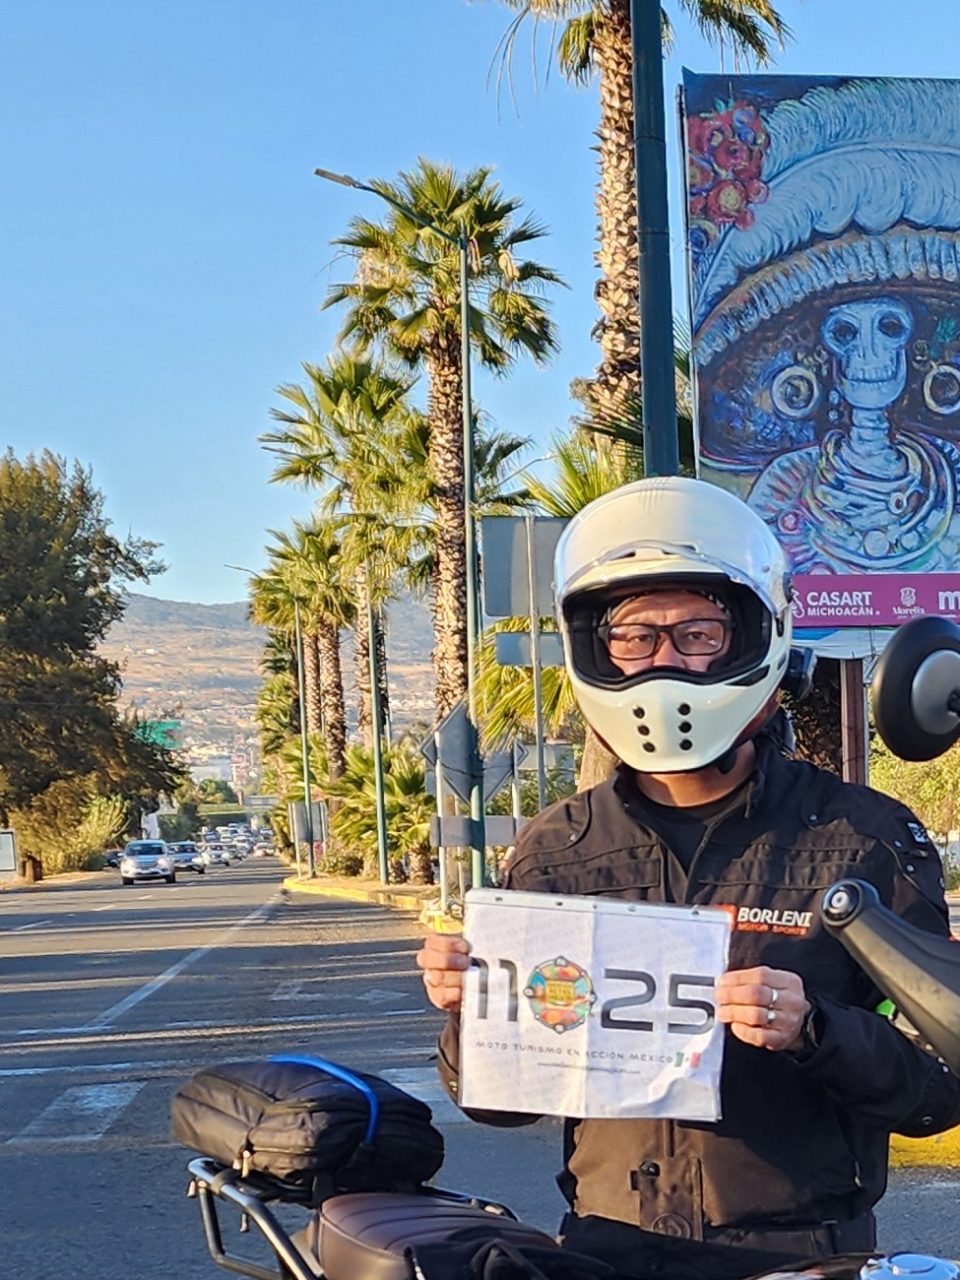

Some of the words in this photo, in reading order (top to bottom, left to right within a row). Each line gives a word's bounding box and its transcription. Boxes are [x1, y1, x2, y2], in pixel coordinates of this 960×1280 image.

[806, 590, 873, 606] CASART
[807, 604, 874, 616] MICHOACÁN
[737, 907, 813, 928] BORLENI
[475, 1041, 508, 1050] MOTO
[513, 1043, 562, 1055] TURISMO
